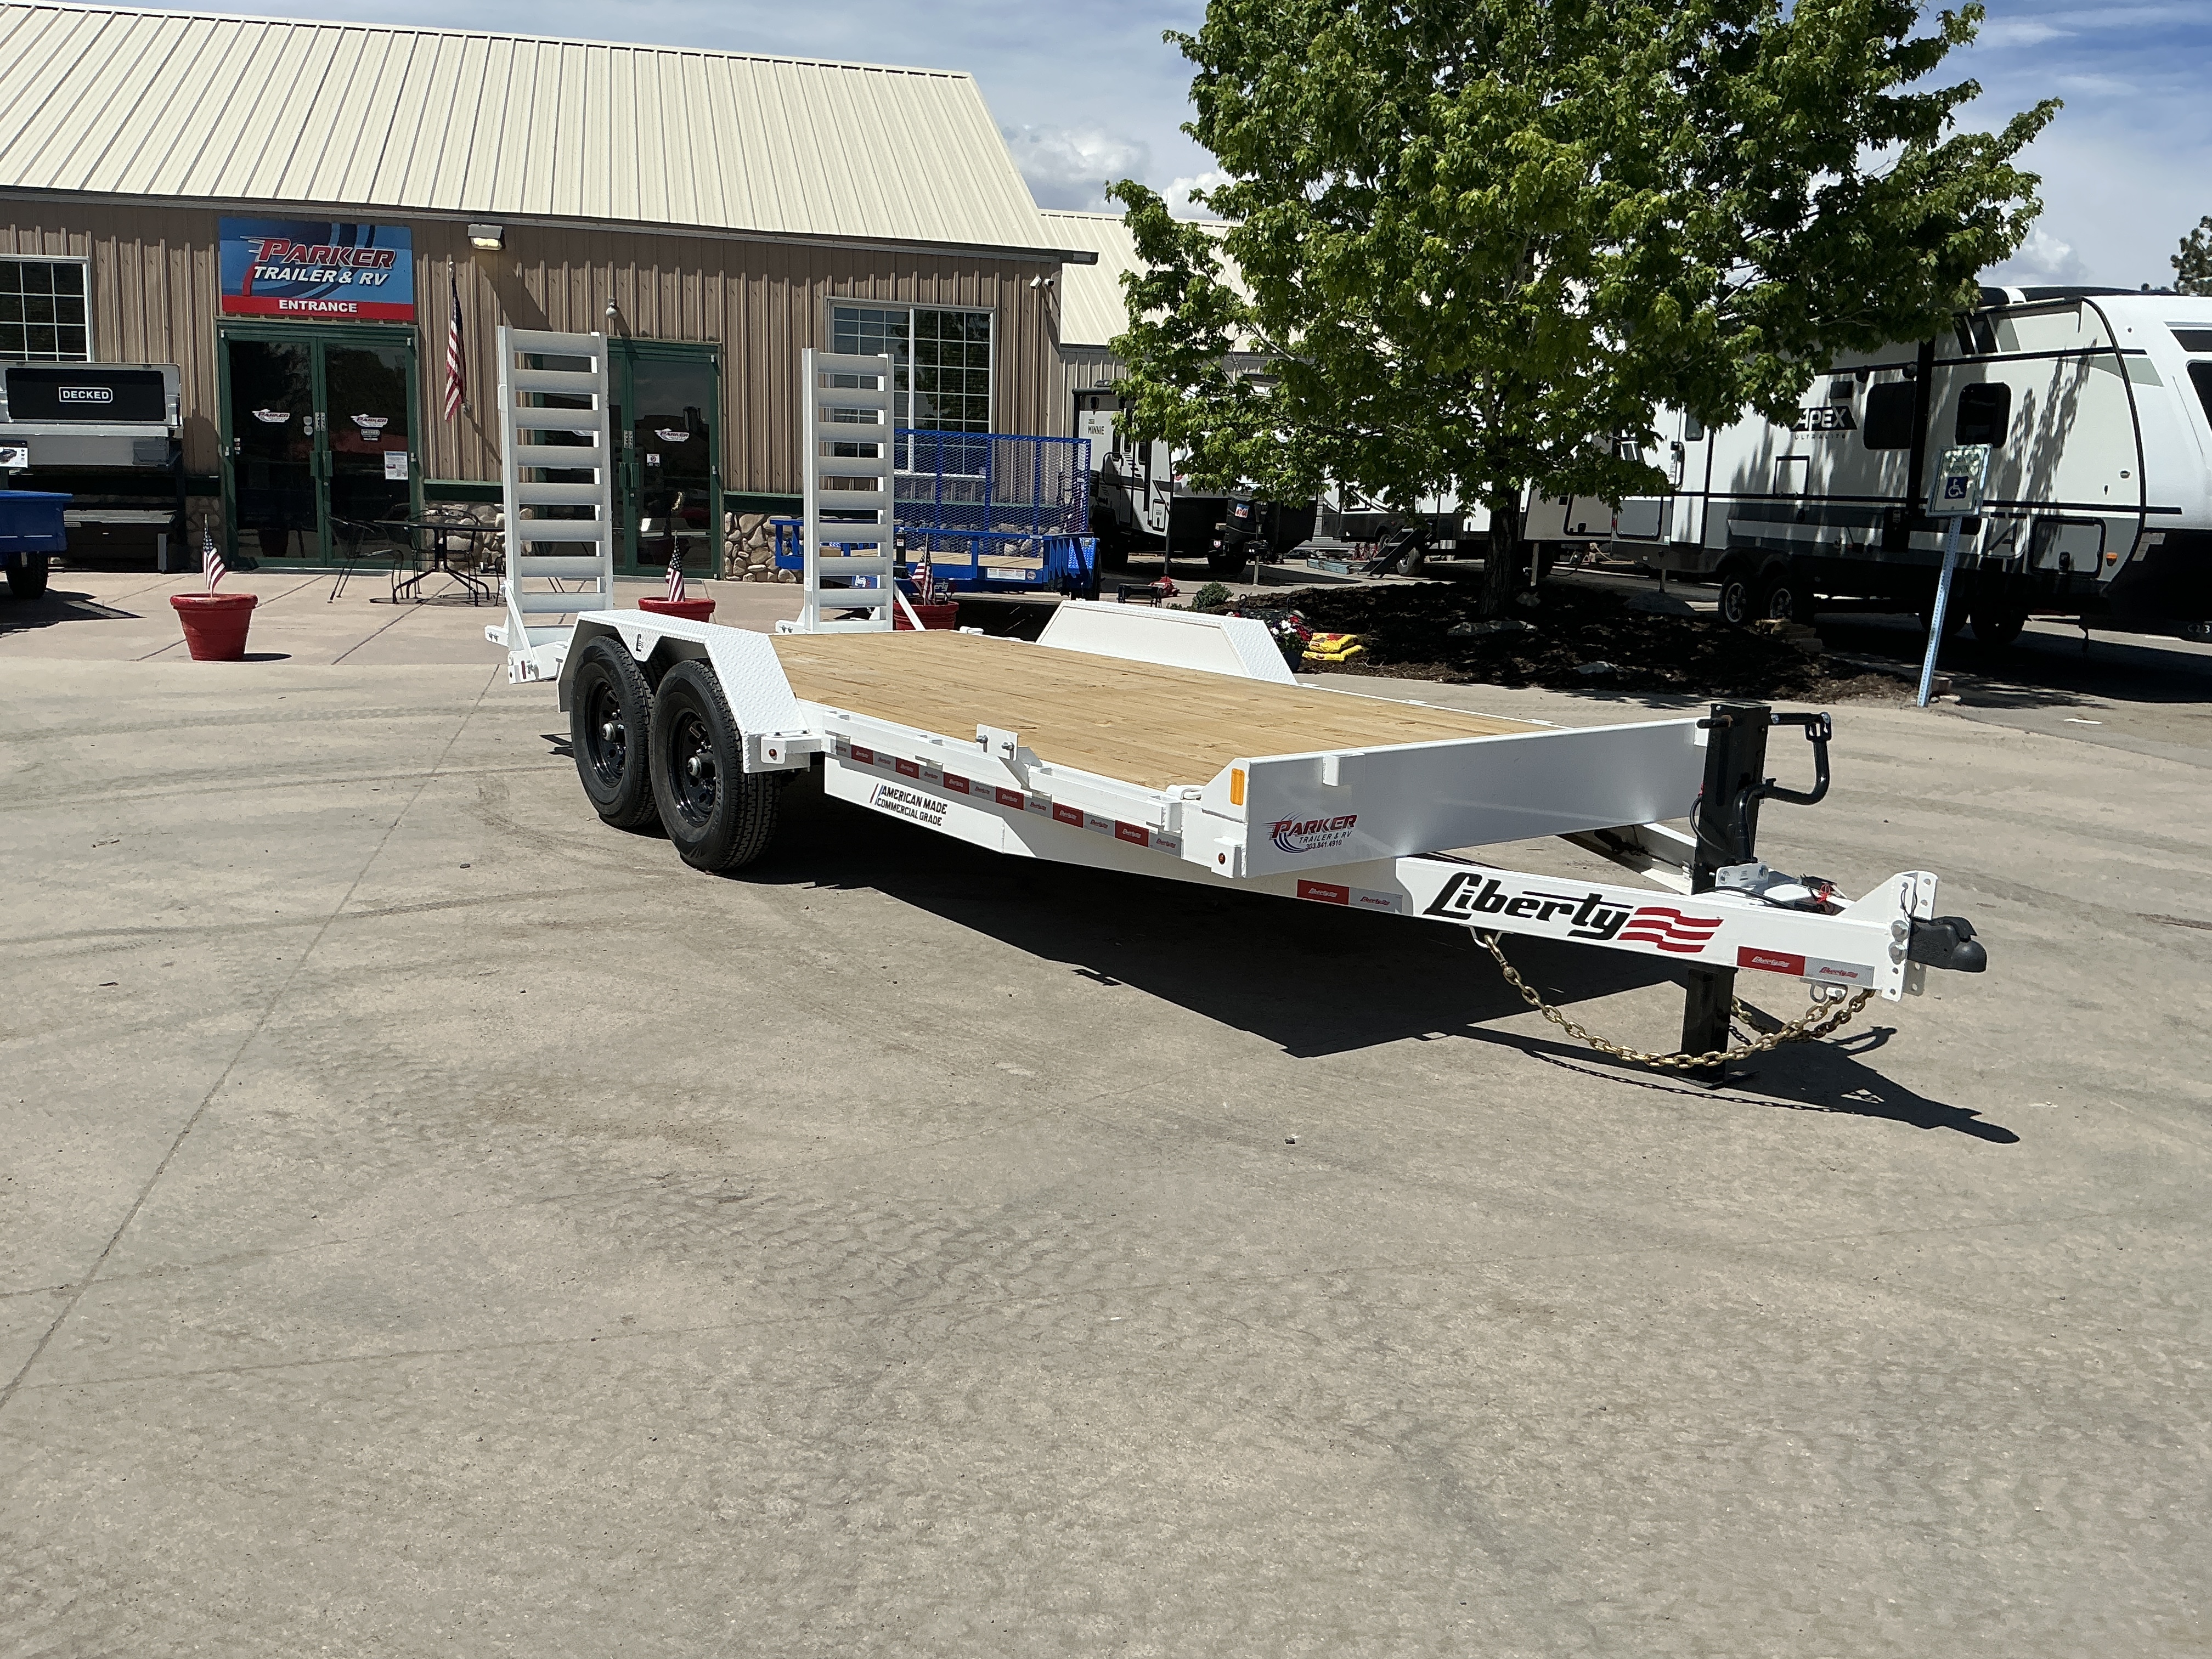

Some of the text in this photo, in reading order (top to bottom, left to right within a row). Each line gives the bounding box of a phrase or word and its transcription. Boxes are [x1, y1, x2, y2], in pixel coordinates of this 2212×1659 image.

[258, 238, 396, 269] PARKER
[254, 266, 389, 286] TRAILER & RV
[279, 300, 358, 313] ENTRANCE
[63, 390, 109, 399] DECKED
[1088, 425, 1104, 435] MINNIE
[1792, 407, 1847, 431] APEX
[881, 785, 948, 815] AMERICAN MADE
[877, 798, 943, 827] COMMERCIAL GRADE
[1271, 814, 1357, 839] PARKER
[1299, 834, 1333, 844] TRAILER
[1341, 830, 1352, 838] RV
[1422, 872, 1634, 941] Liberty
